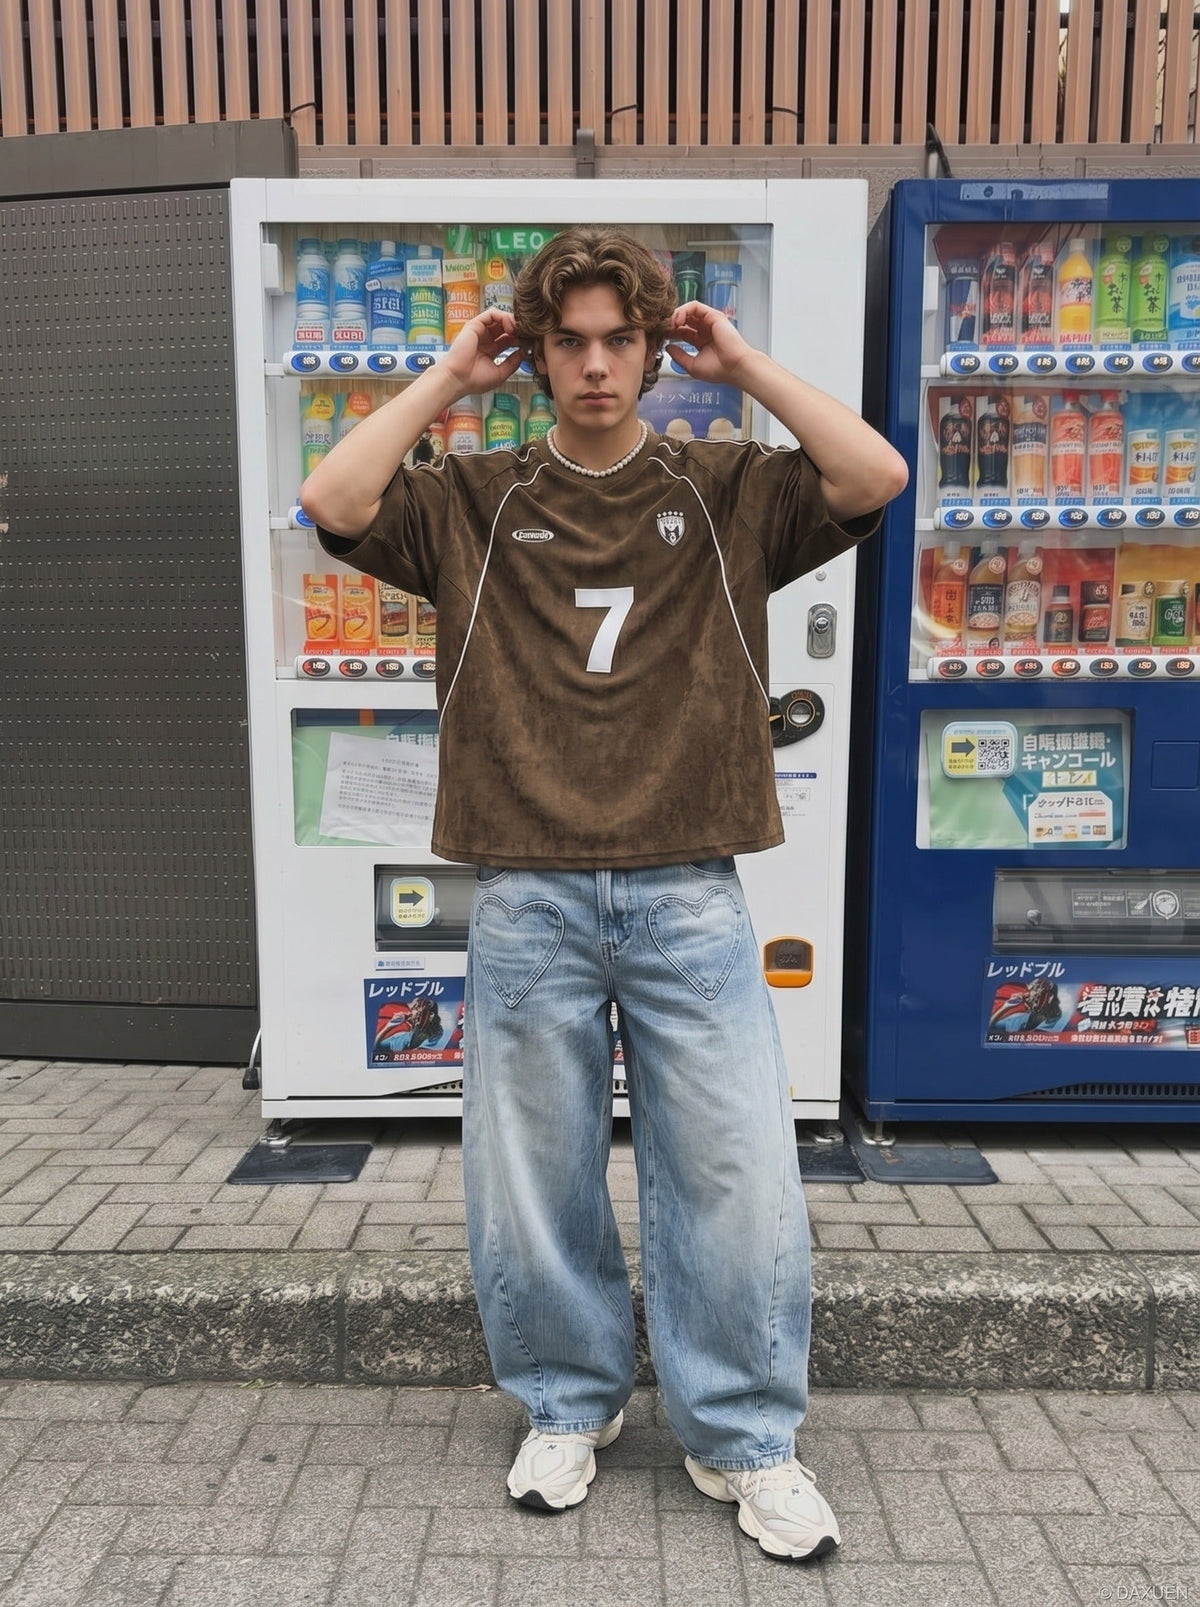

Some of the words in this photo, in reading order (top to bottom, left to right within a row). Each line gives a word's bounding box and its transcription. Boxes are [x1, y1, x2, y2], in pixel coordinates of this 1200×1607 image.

[574, 586, 635, 674] 7
[1021, 751, 1117, 770] キャンコール
[986, 961, 1066, 979] レッドブル
[368, 980, 445, 998] レッドブル
